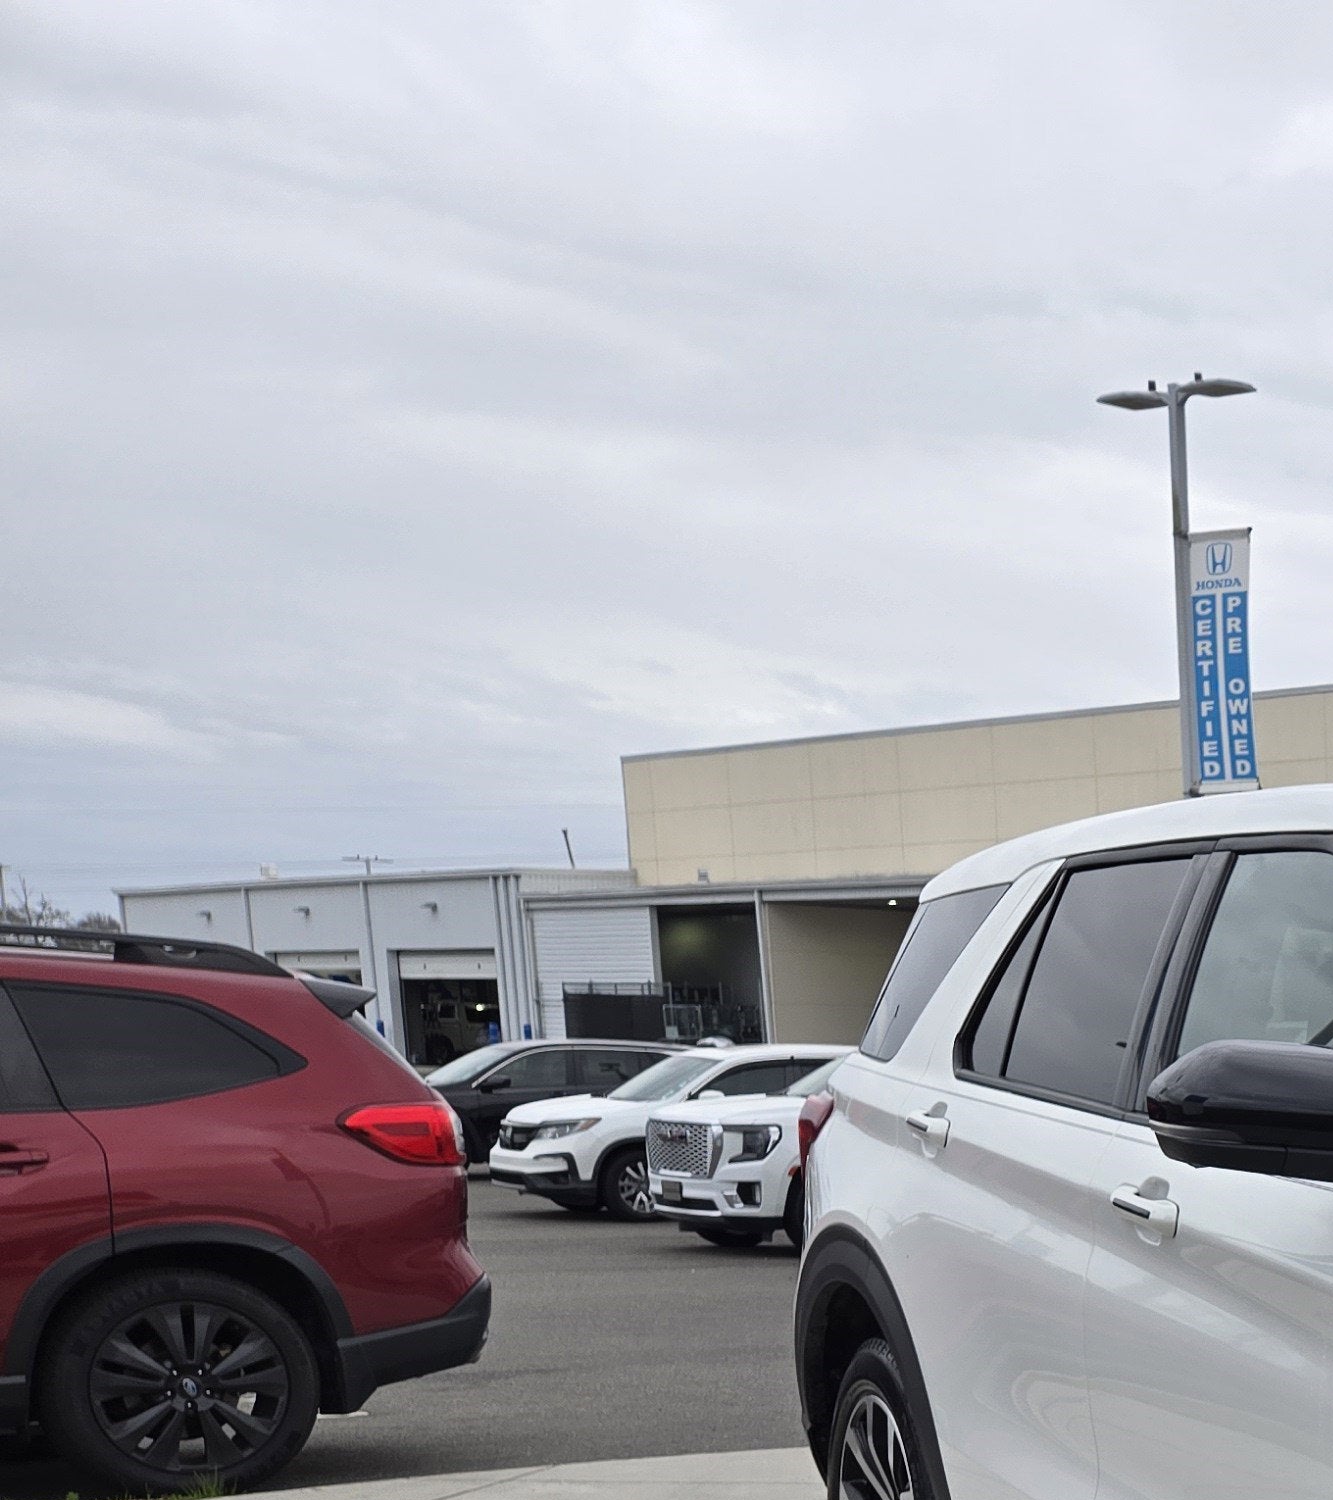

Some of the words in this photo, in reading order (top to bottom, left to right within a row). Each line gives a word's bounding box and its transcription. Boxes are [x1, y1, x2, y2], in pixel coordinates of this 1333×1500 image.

[1195, 578, 1242, 591] HONDA
[1226, 595, 1243, 654] PRE
[1195, 598, 1221, 777] CERTIFIED
[1227, 677, 1252, 776] OWNED
